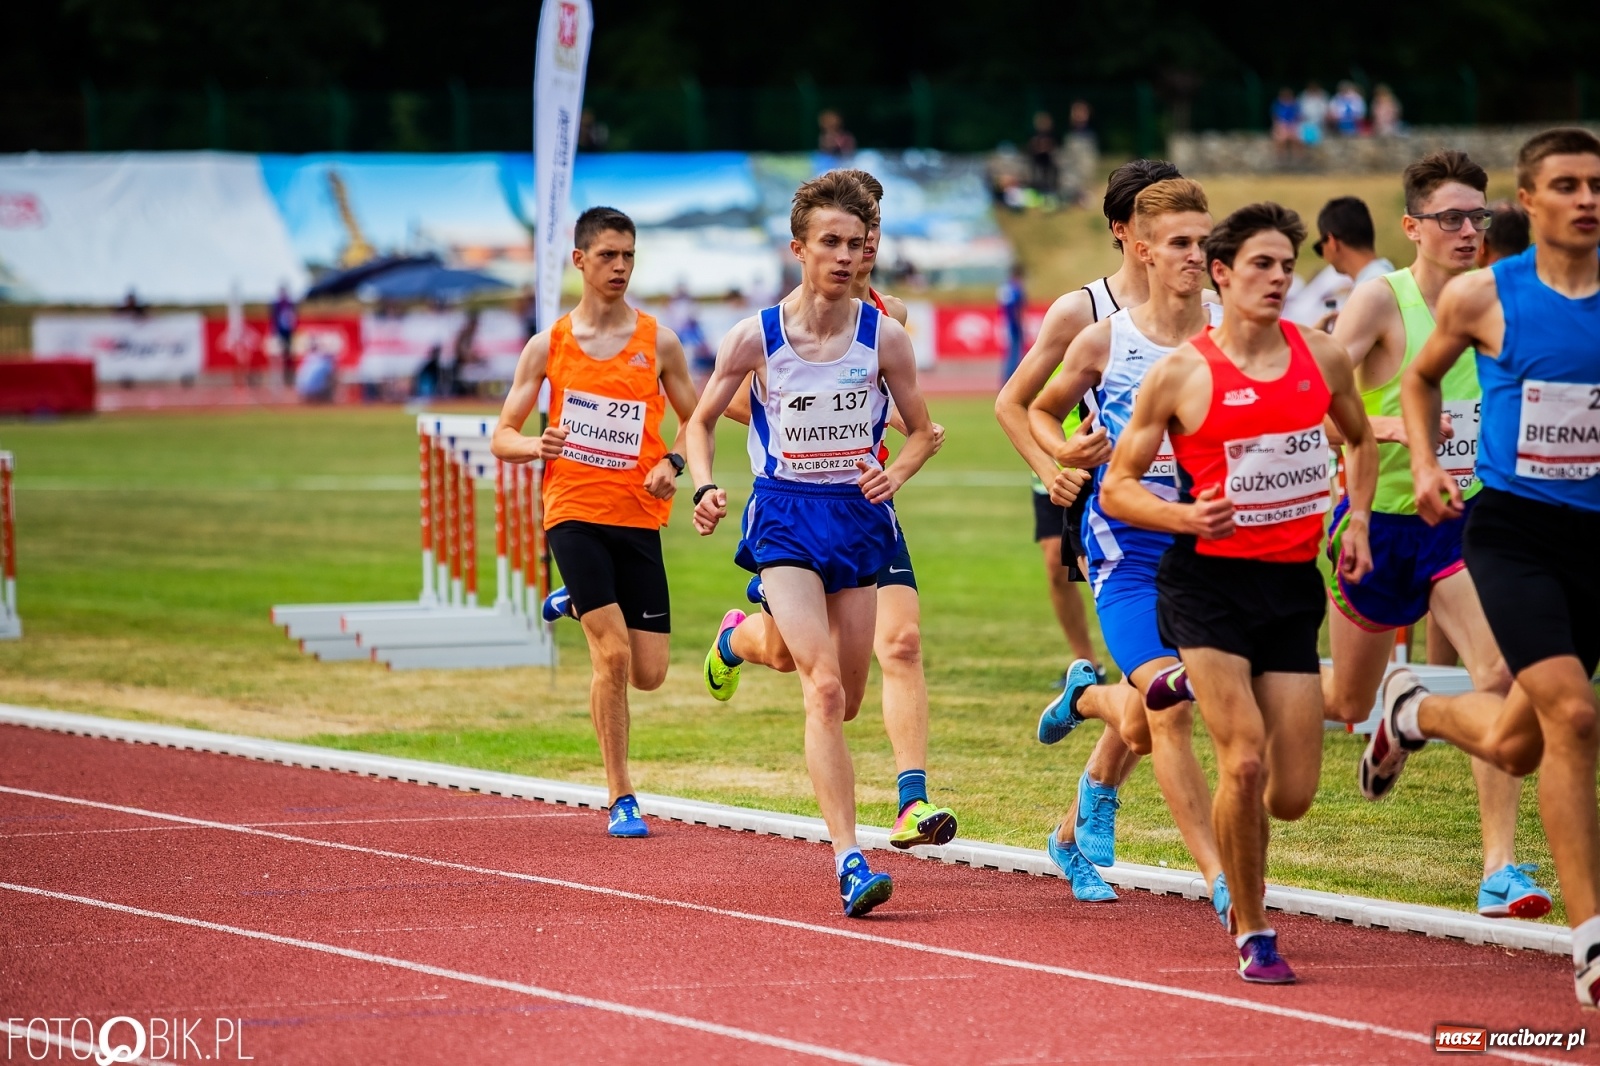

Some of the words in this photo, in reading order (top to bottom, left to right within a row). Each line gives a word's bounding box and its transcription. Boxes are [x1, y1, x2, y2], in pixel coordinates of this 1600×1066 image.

[788, 396, 816, 411] 4F
[832, 390, 868, 411] 137
[606, 402, 641, 421] 291
[563, 418, 639, 446] KUCHARSKI
[785, 422, 869, 441] WIATRZYK
[1526, 424, 1600, 444] BIERNA
[1285, 430, 1321, 455] 369
[564, 449, 605, 465] RACIBÓRZ
[607, 459, 626, 468] 2019
[792, 459, 840, 470] RACIBÓRZ
[842, 458, 864, 468] 20
[1230, 464, 1326, 492] GUŻKOWSKI
[1239, 509, 1293, 523] RACIBÓRZ
[1296, 503, 1317, 516] 2019
